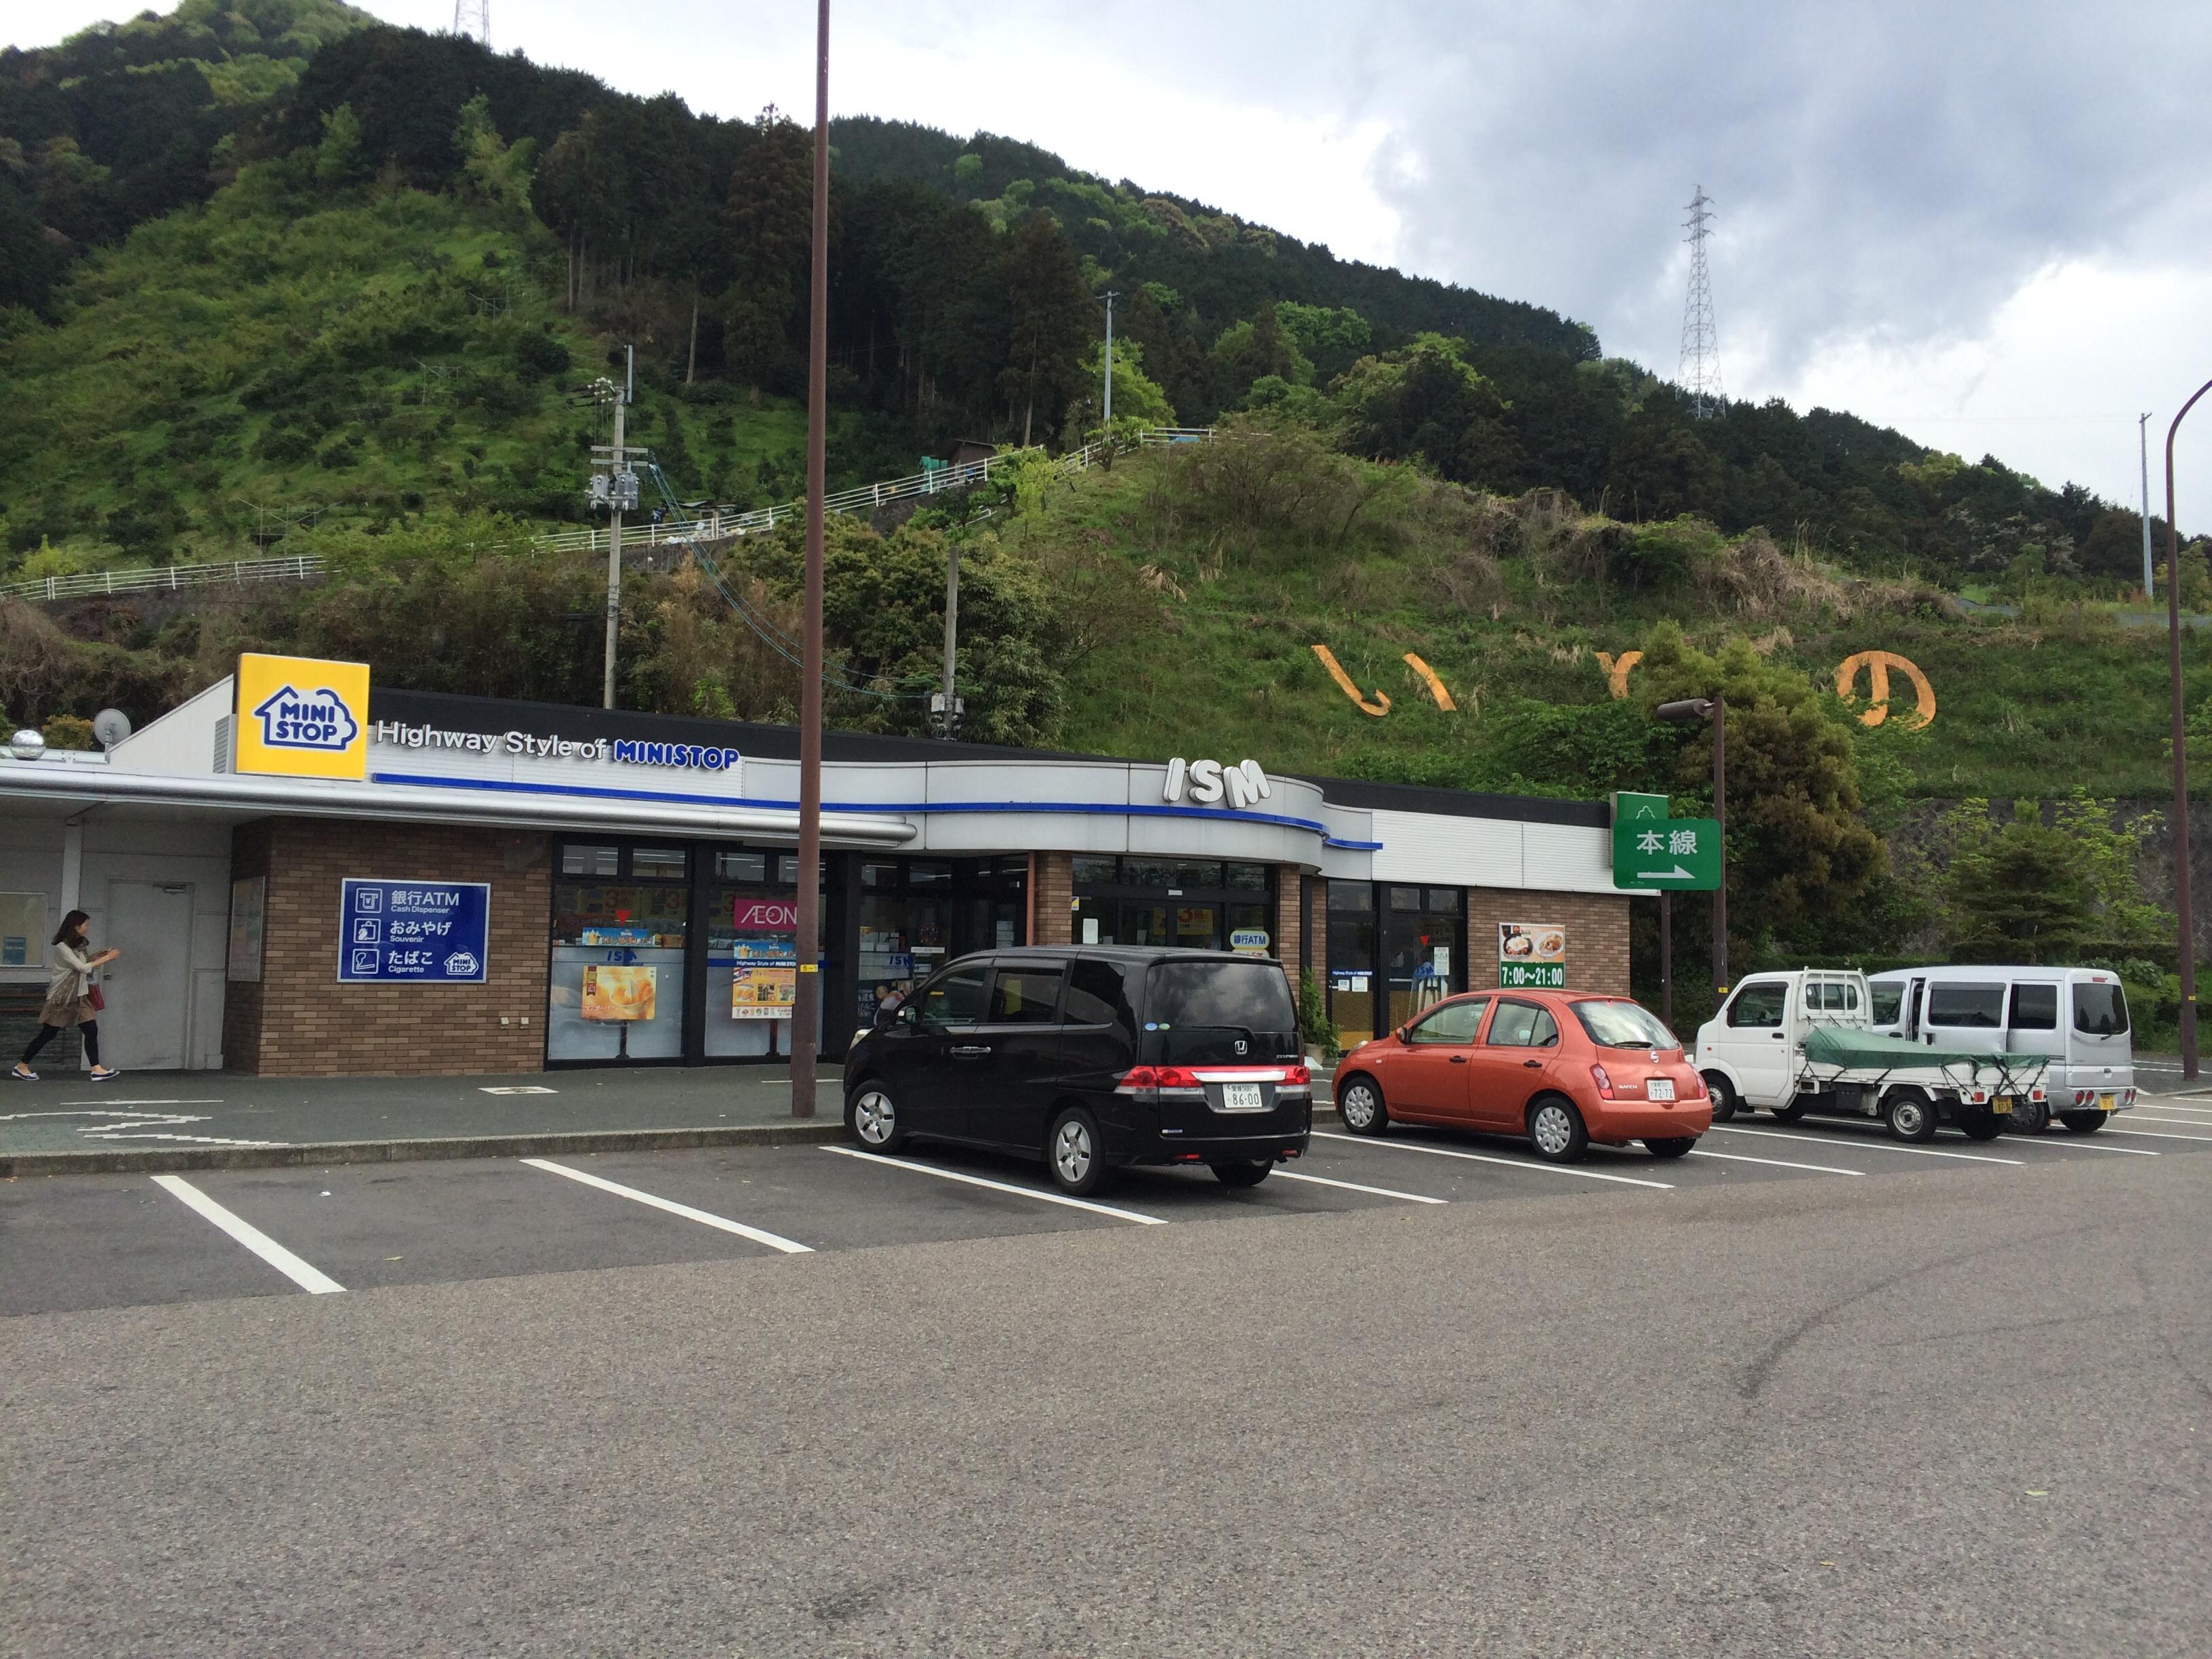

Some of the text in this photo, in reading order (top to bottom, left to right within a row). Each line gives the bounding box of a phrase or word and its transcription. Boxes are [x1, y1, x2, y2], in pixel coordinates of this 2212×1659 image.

[280, 701, 335, 723] MINI
[276, 720, 337, 741] STOP
[375, 720, 739, 770] Highway Style of MINISTOP
[1163, 757, 1271, 808] ISM
[1636, 830, 1698, 855] 本線
[391, 890, 459, 906] 銀行ATM
[411, 906, 450, 914] Dispenser
[390, 920, 452, 936] おみやげ
[1234, 934, 1265, 945] 銀行ATM
[388, 950, 433, 965] たばこ
[388, 966, 424, 974] Cigarette
